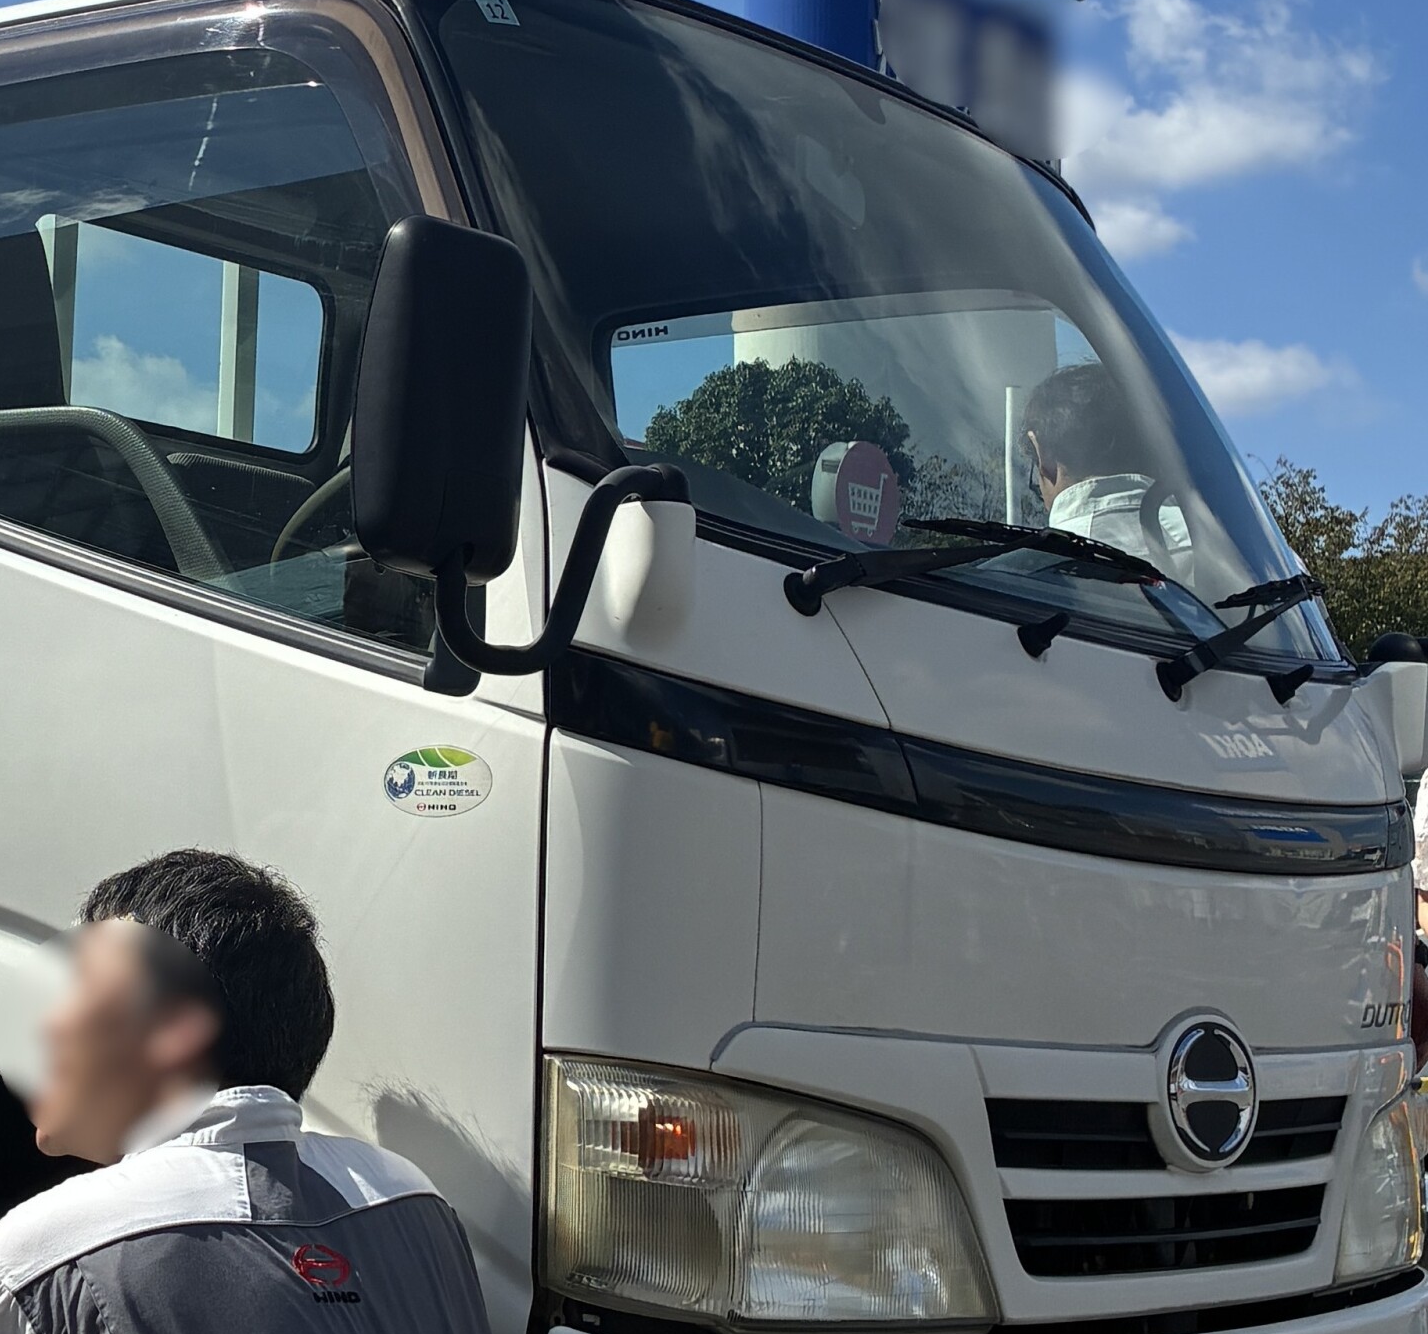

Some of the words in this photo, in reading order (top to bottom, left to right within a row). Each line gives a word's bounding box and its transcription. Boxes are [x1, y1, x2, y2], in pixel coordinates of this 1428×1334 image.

[486, 3, 510, 20] 12
[414, 788, 447, 797] CLEAN
[448, 789, 481, 797] DIESEL
[313, 1290, 362, 1304] HINO
